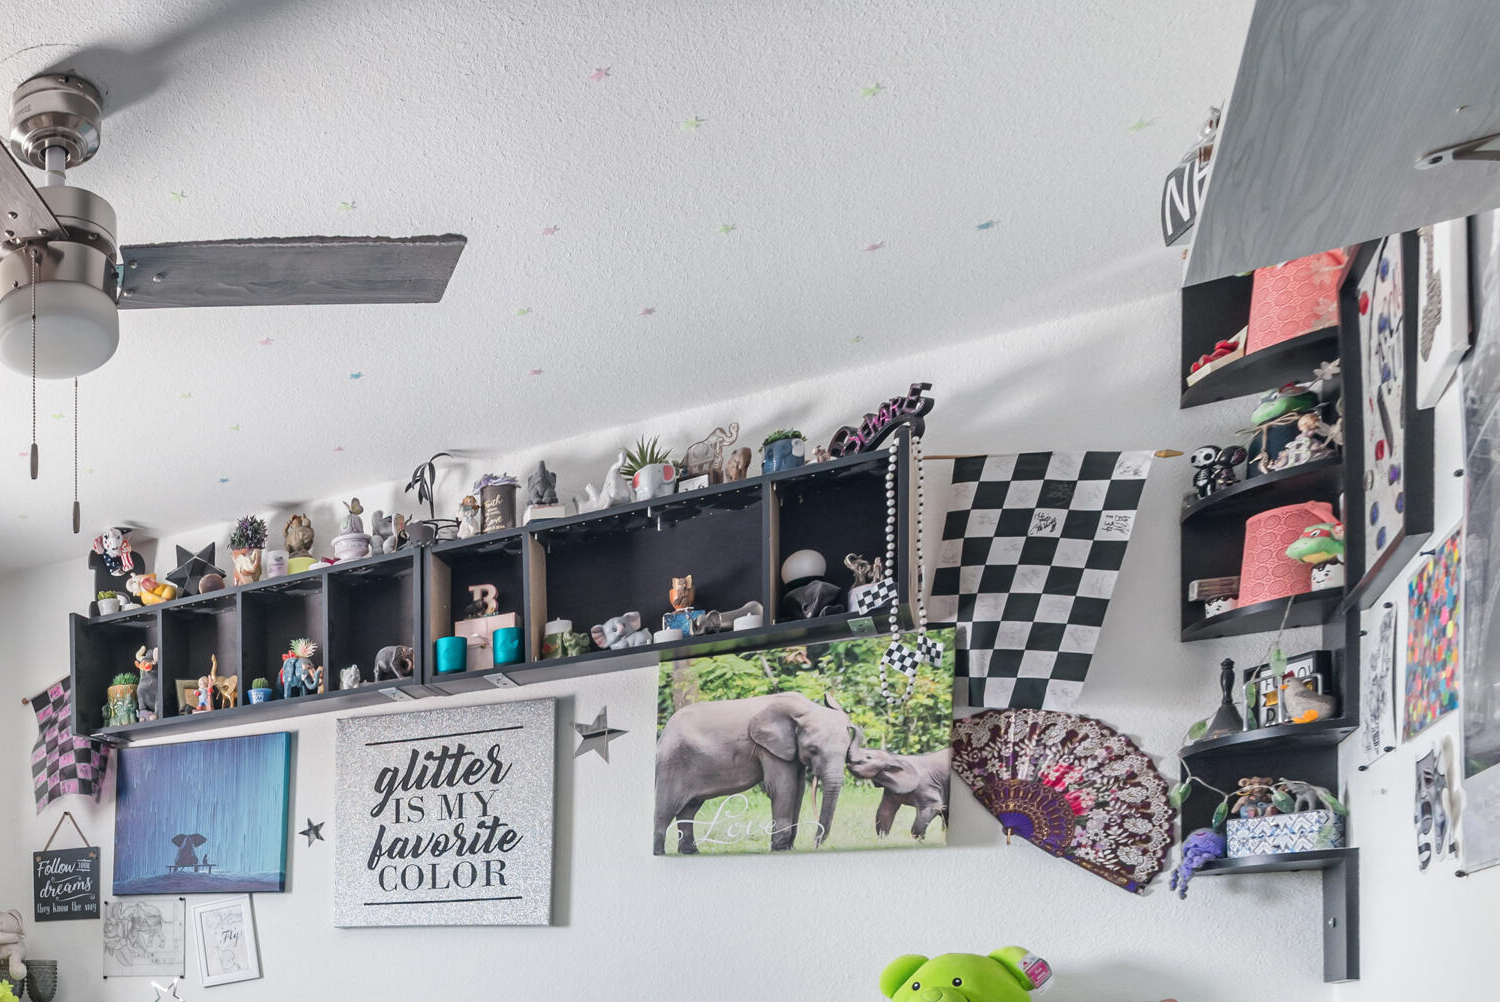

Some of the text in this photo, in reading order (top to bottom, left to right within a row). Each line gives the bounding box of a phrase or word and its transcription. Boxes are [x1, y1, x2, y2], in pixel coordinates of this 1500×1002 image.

[370, 743, 513, 818] glitter
[392, 789, 500, 824] IS MY
[367, 815, 524, 871] favorite
[37, 857, 76, 878] Follow
[378, 859, 508, 892] COLOR
[40, 877, 93, 898] dreams
[37, 901, 97, 915] they know the way
